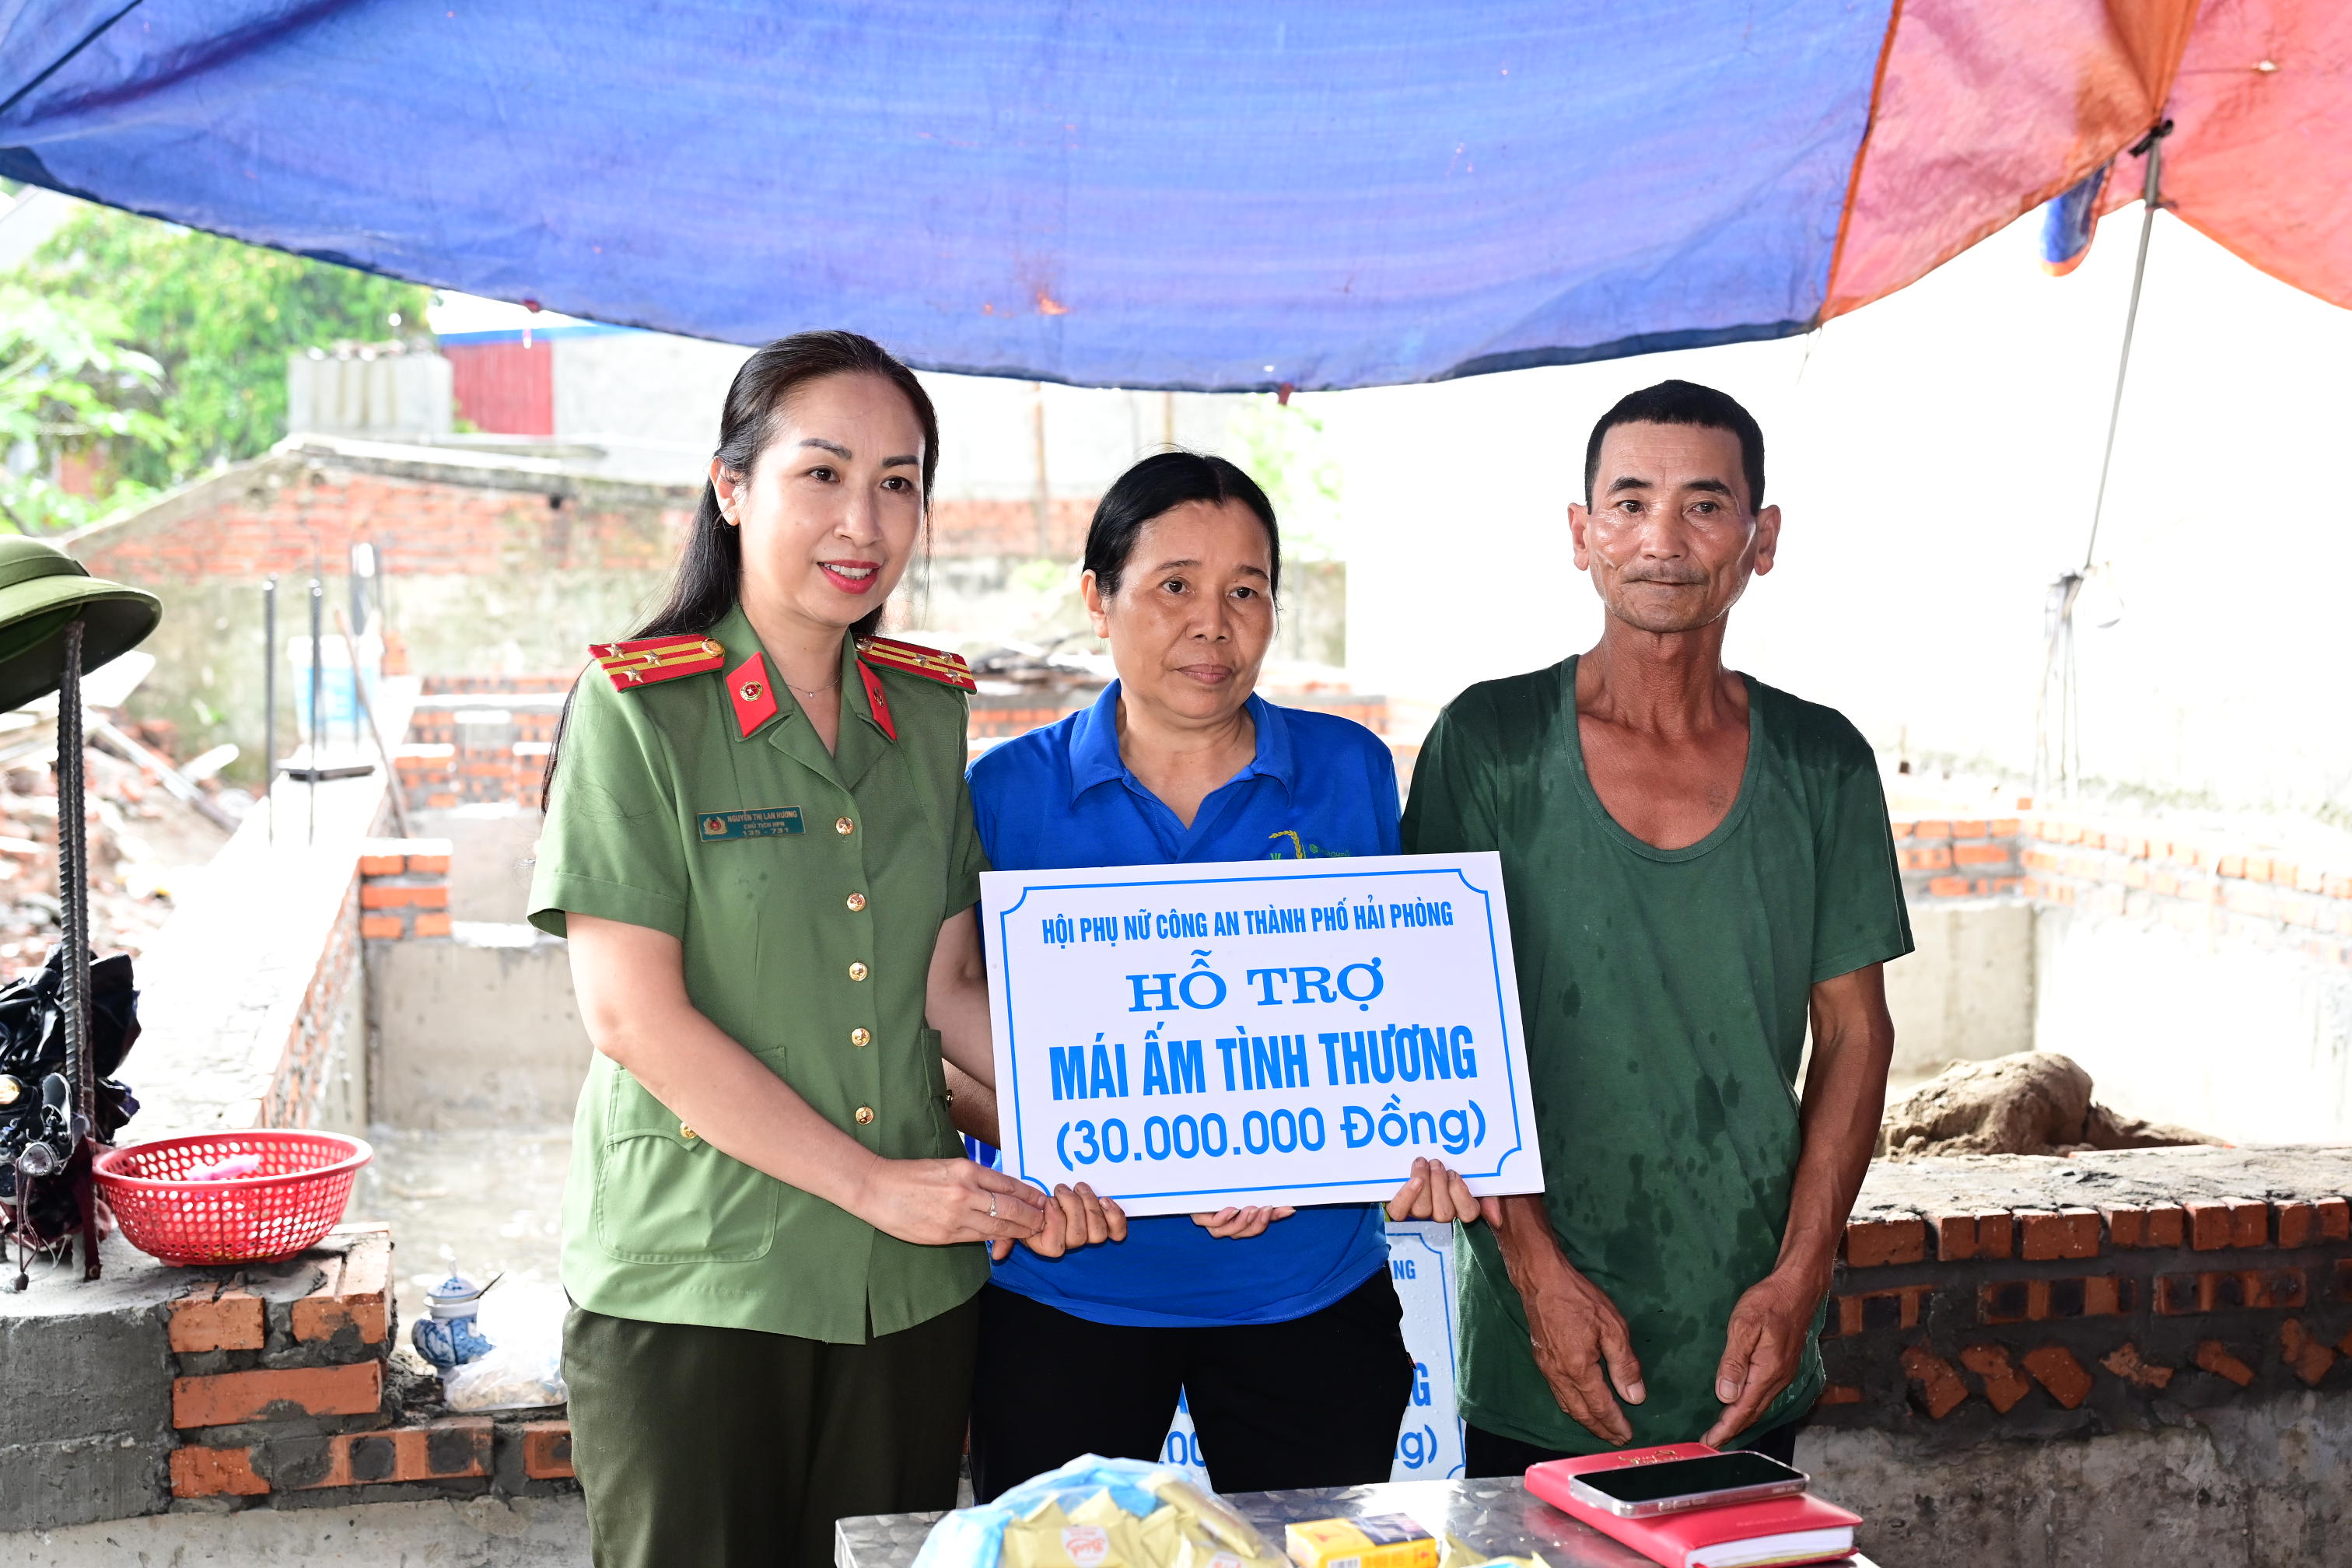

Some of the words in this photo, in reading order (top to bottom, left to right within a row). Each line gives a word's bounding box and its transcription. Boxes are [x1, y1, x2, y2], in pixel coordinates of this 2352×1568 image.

[1042, 913, 1075, 949] HỘI
[1080, 916, 1118, 947] PHỤ
[1124, 908, 1151, 940] NỮ
[1156, 908, 1209, 939] CÔNG
[1214, 911, 1240, 936] AN
[1244, 905, 1307, 935] THÀNH
[1311, 898, 1349, 932] PHỐ
[1353, 894, 1385, 929] HẢI
[1390, 897, 1454, 928] PHÒNG
[1125, 950, 1227, 1012] HỖ
[1246, 957, 1384, 1011] TRỢ
[1049, 1032, 1129, 1101] MÁI
[1143, 1021, 1206, 1096] ẤM
[1216, 1025, 1310, 1091] TÌNH
[1318, 1024, 1478, 1086] THƯƠNG
[1057, 1108, 1325, 1171] (30.000.000
[1340, 1094, 1486, 1155] Đồng)
[1392, 1259, 1416, 1279] NG
